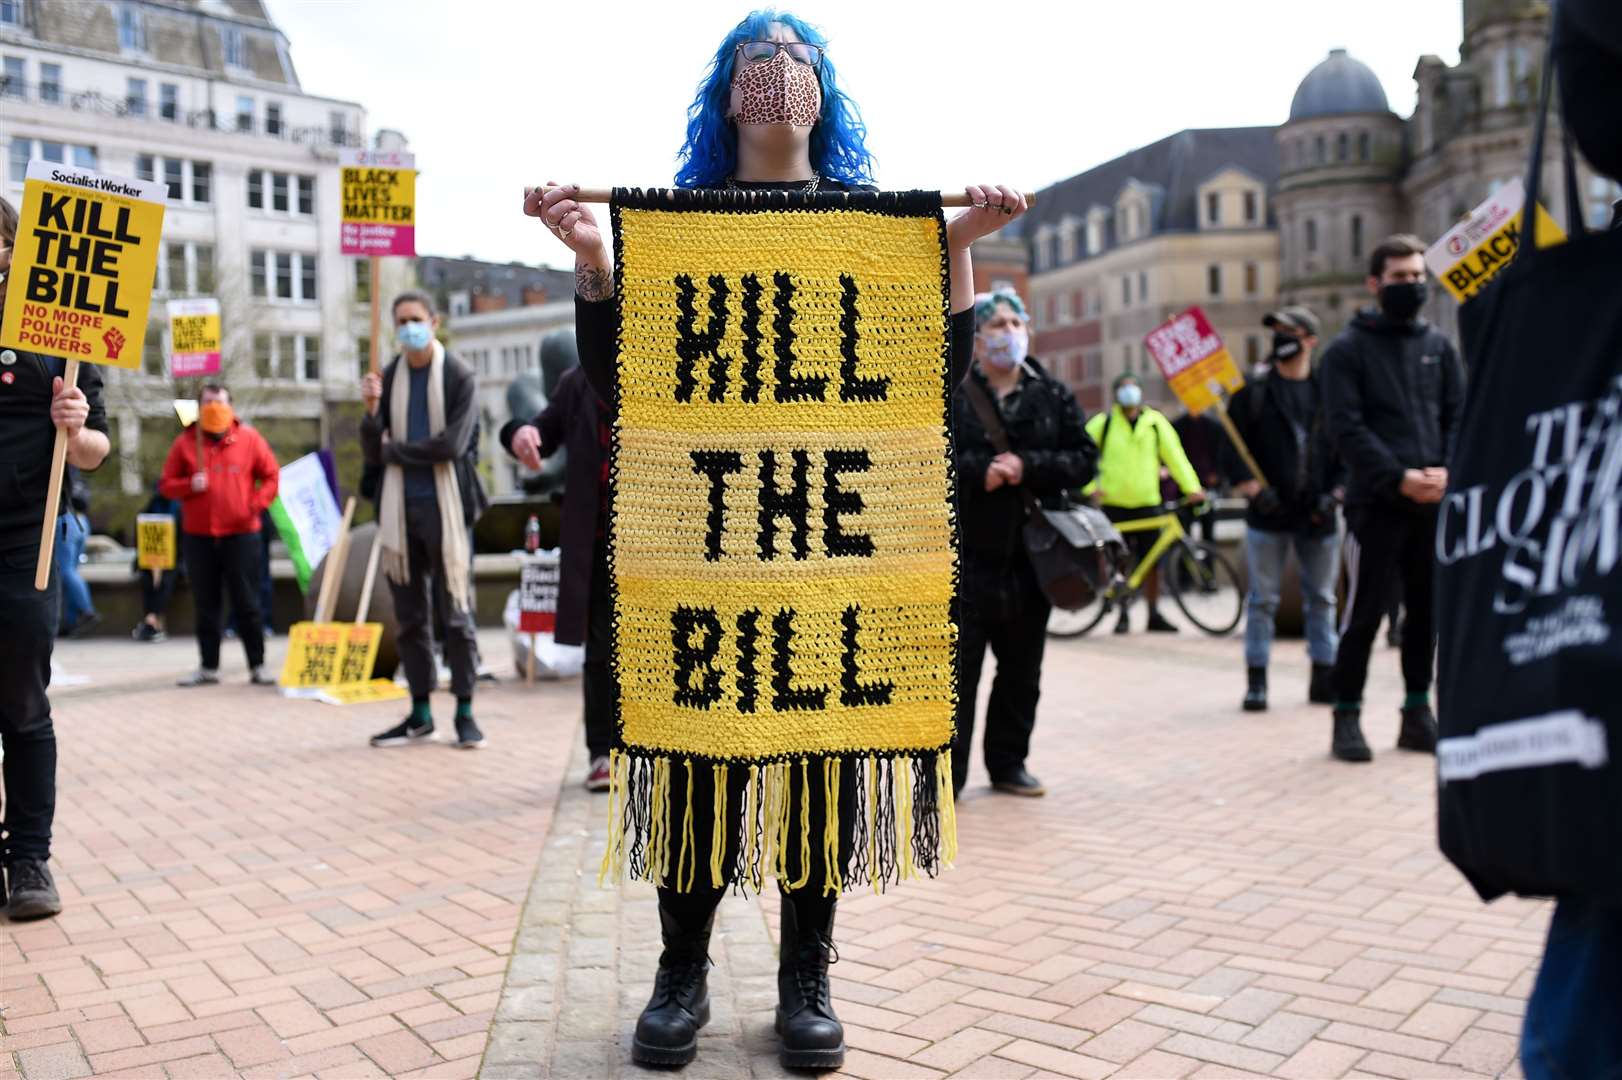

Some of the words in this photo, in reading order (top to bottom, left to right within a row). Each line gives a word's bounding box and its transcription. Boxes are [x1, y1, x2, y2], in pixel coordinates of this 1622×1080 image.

[51, 170, 99, 189] Socialist
[101, 180, 142, 197] Worker
[343, 168, 399, 184] BLACK
[343, 187, 391, 203] LIVES
[38, 192, 141, 245] KILL
[343, 204, 412, 221] MATTER
[33, 228, 123, 278] THE
[1448, 222, 1519, 291] BLACK
[26, 266, 129, 318] BILL
[21, 318, 82, 339] POLICE
[23, 304, 48, 319] NO
[52, 309, 104, 329] MORE
[18, 331, 93, 355] POWERS
[673, 271, 892, 402] KILL
[690, 449, 875, 561] THE
[671, 604, 895, 712] BILL
